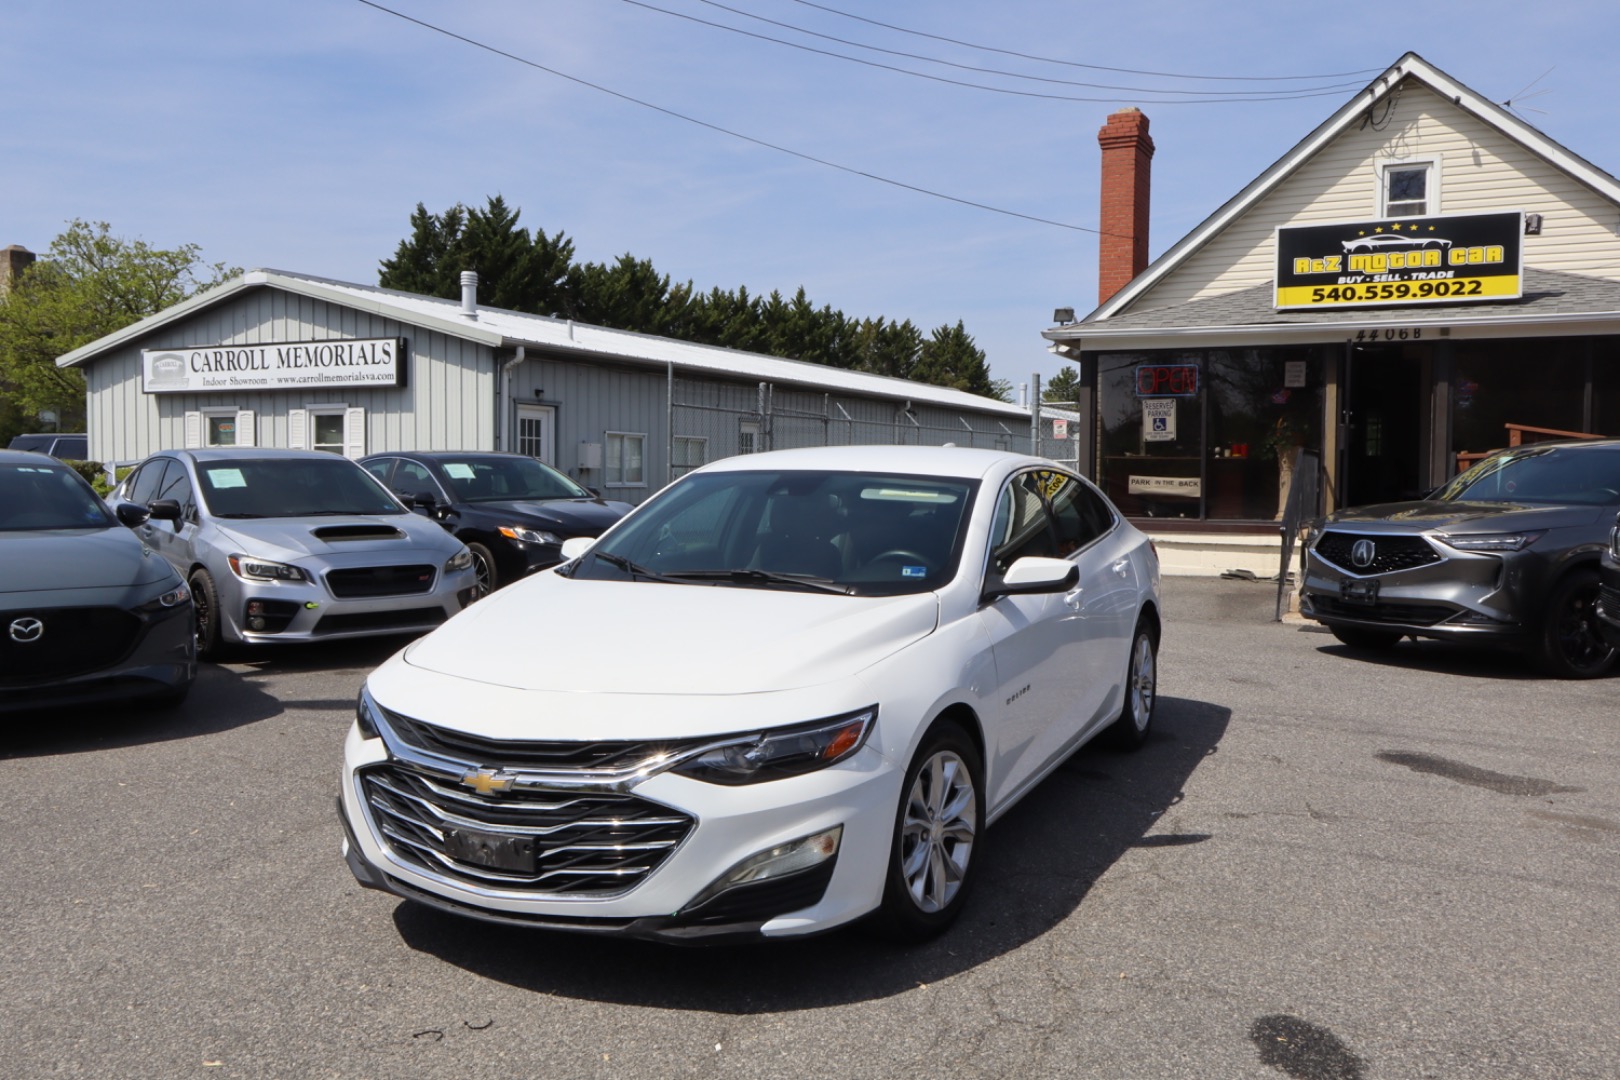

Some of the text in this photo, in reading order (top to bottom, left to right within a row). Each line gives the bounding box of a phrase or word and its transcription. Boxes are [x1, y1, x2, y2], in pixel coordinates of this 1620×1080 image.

[1337, 270, 1455, 285] BUY SELL TRADE
[1311, 280, 1483, 303] 540.559.9022
[190, 342, 392, 373] CARROLL MEMORIALS
[202, 371, 395, 387] Indoor Showroom www.carrollmemorialsva.com
[1138, 367, 1196, 394] OPEN
[1144, 402, 1174, 410] RESERVED
[1147, 410, 1172, 418] PARKING
[1131, 478, 1151, 486] PARK
